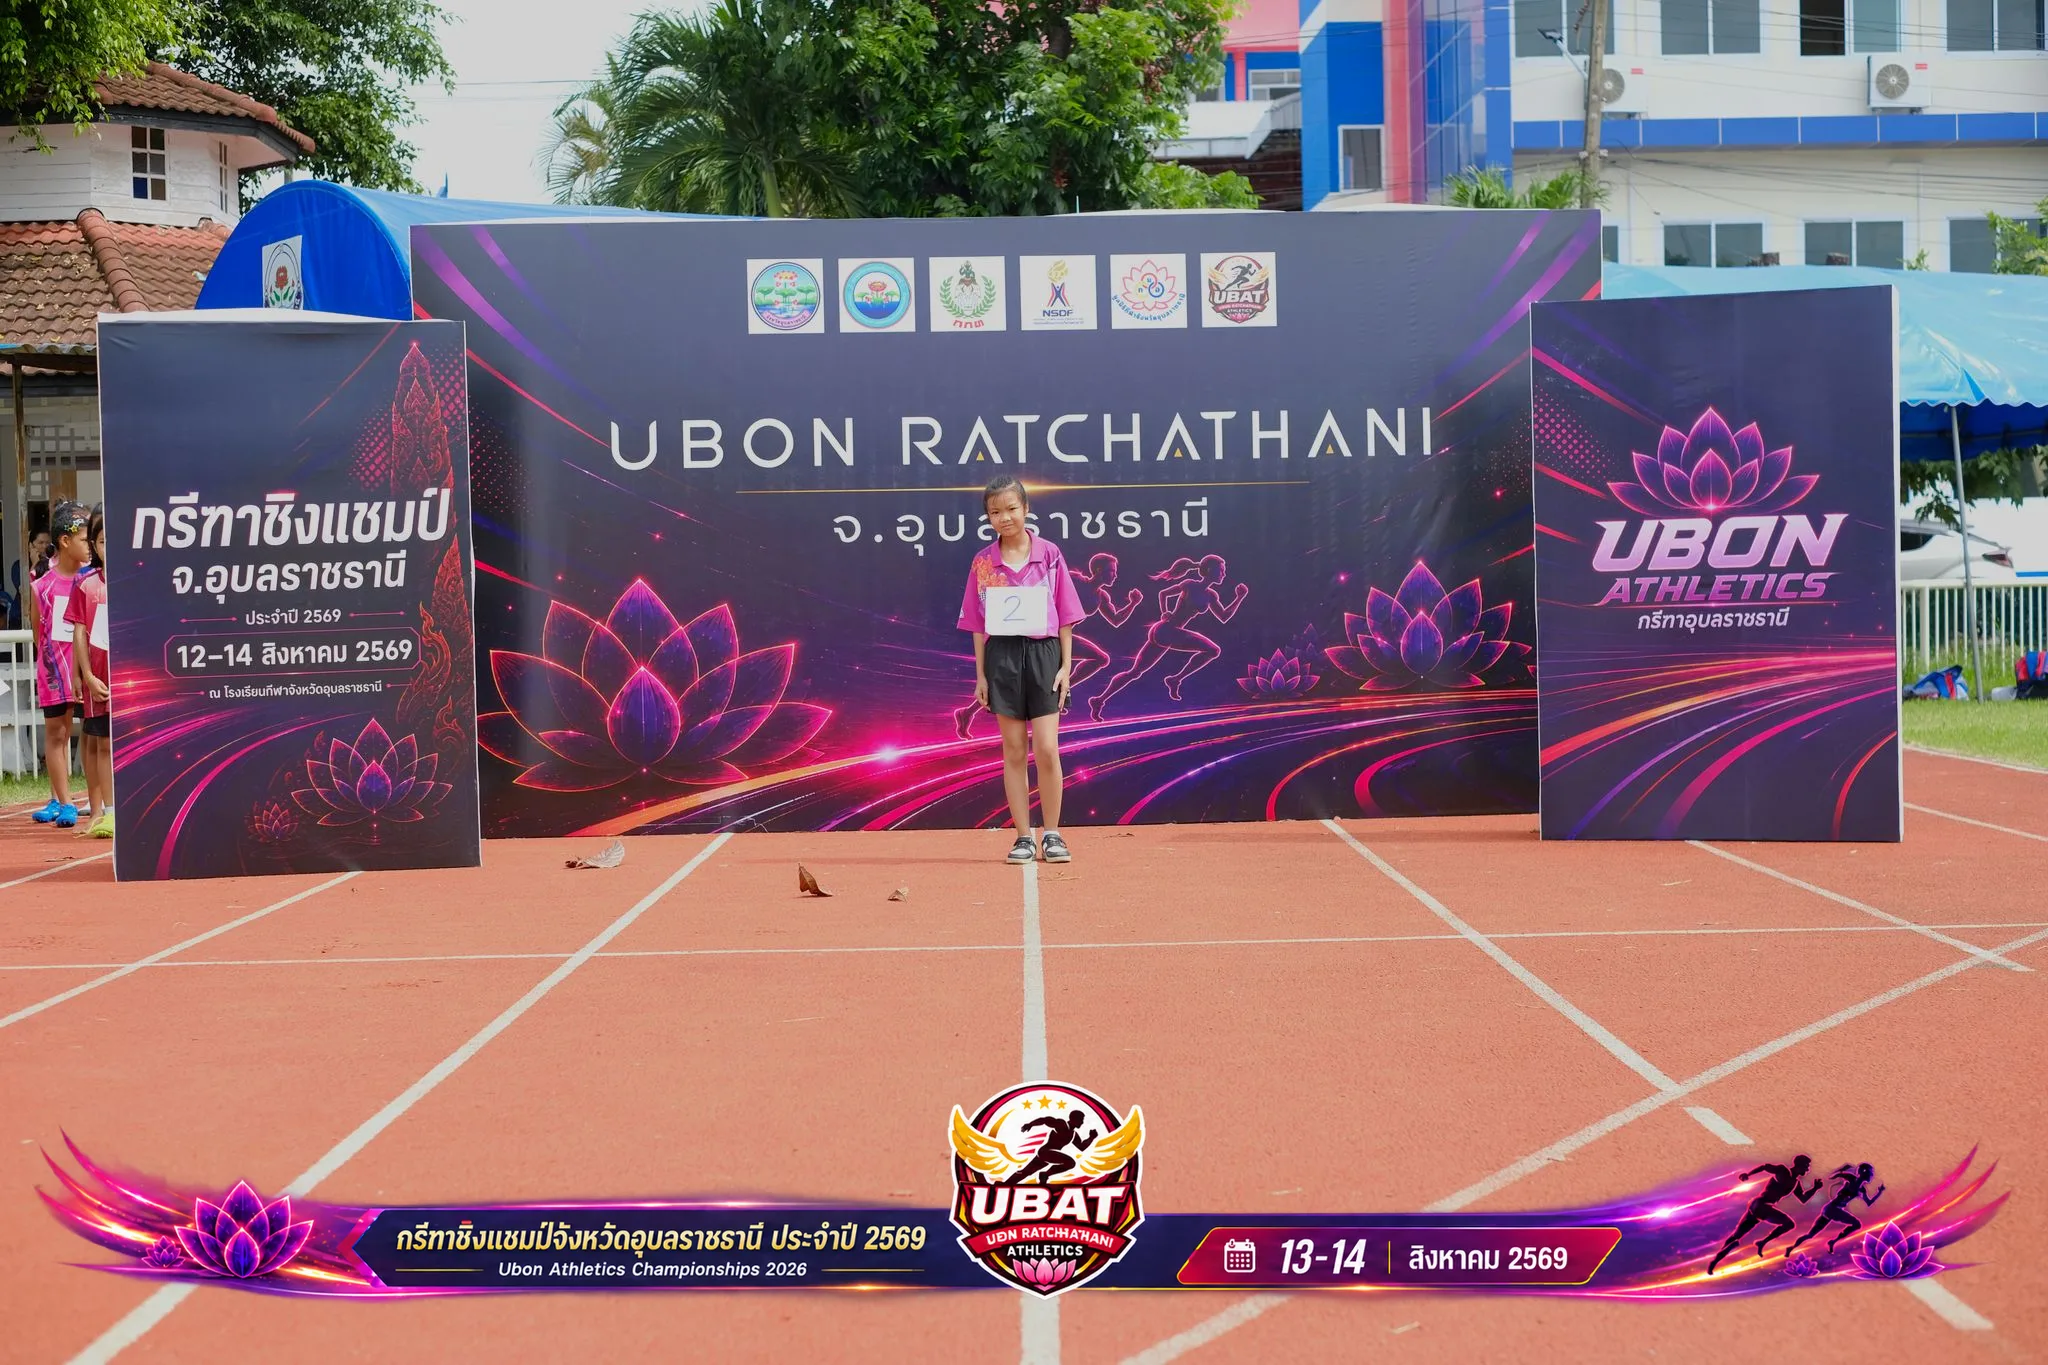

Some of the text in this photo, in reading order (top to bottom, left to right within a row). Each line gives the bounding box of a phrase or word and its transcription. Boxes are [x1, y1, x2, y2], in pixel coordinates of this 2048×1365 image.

[1214, 290, 1265, 304] UBAT
[1043, 309, 1074, 317] NSDF
[611, 407, 1432, 471] UBON RATCHATHANI
[132, 487, 451, 549] กรีฑาชิงแชมป์
[1592, 513, 1849, 572] UBON
[172, 550, 407, 604] จ.อุบลราชธานี
[1586, 572, 1841, 606] ATHLETICS
[245, 609, 342, 625] ประจำปี 2569
[1002, 595, 1026, 622] 2
[1637, 607, 1790, 634] กรีฑาอุบลราชธานี
[261, 642, 348, 666] สิงหาคม
[355, 639, 413, 661] 2569
[209, 680, 383, 699] ณ โรงเรียนกีฬาจังหวัดอุบลราชธานี
